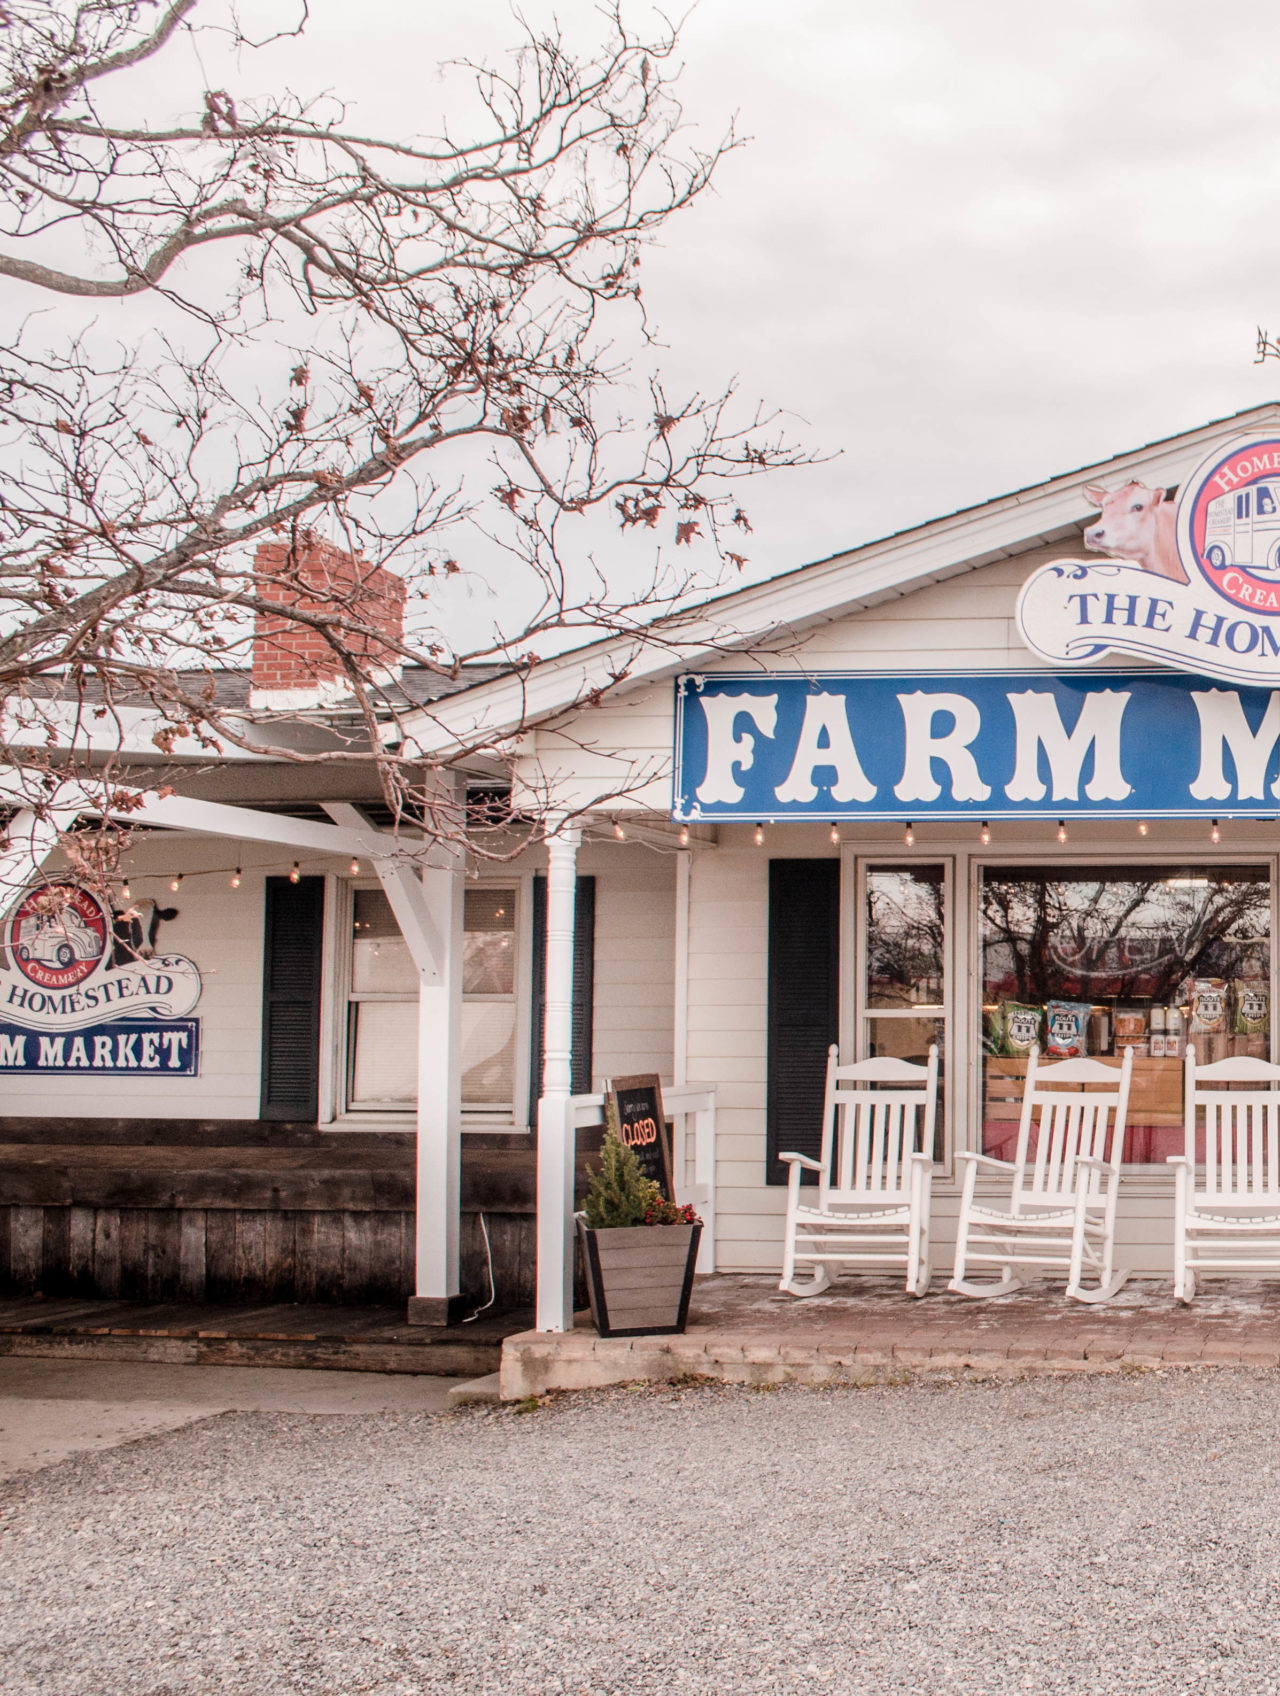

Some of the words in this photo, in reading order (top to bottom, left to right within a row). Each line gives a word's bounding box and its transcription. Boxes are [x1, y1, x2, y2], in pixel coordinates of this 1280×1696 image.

[1067, 592, 1174, 633] THE
[695, 687, 1133, 804] FARM
[26, 962, 89, 985] CREAMERY
[6, 975, 174, 1016] HOMESTEAD
[36, 1031, 188, 1069] MARKET
[622, 1117, 657, 1146] CLOSED
